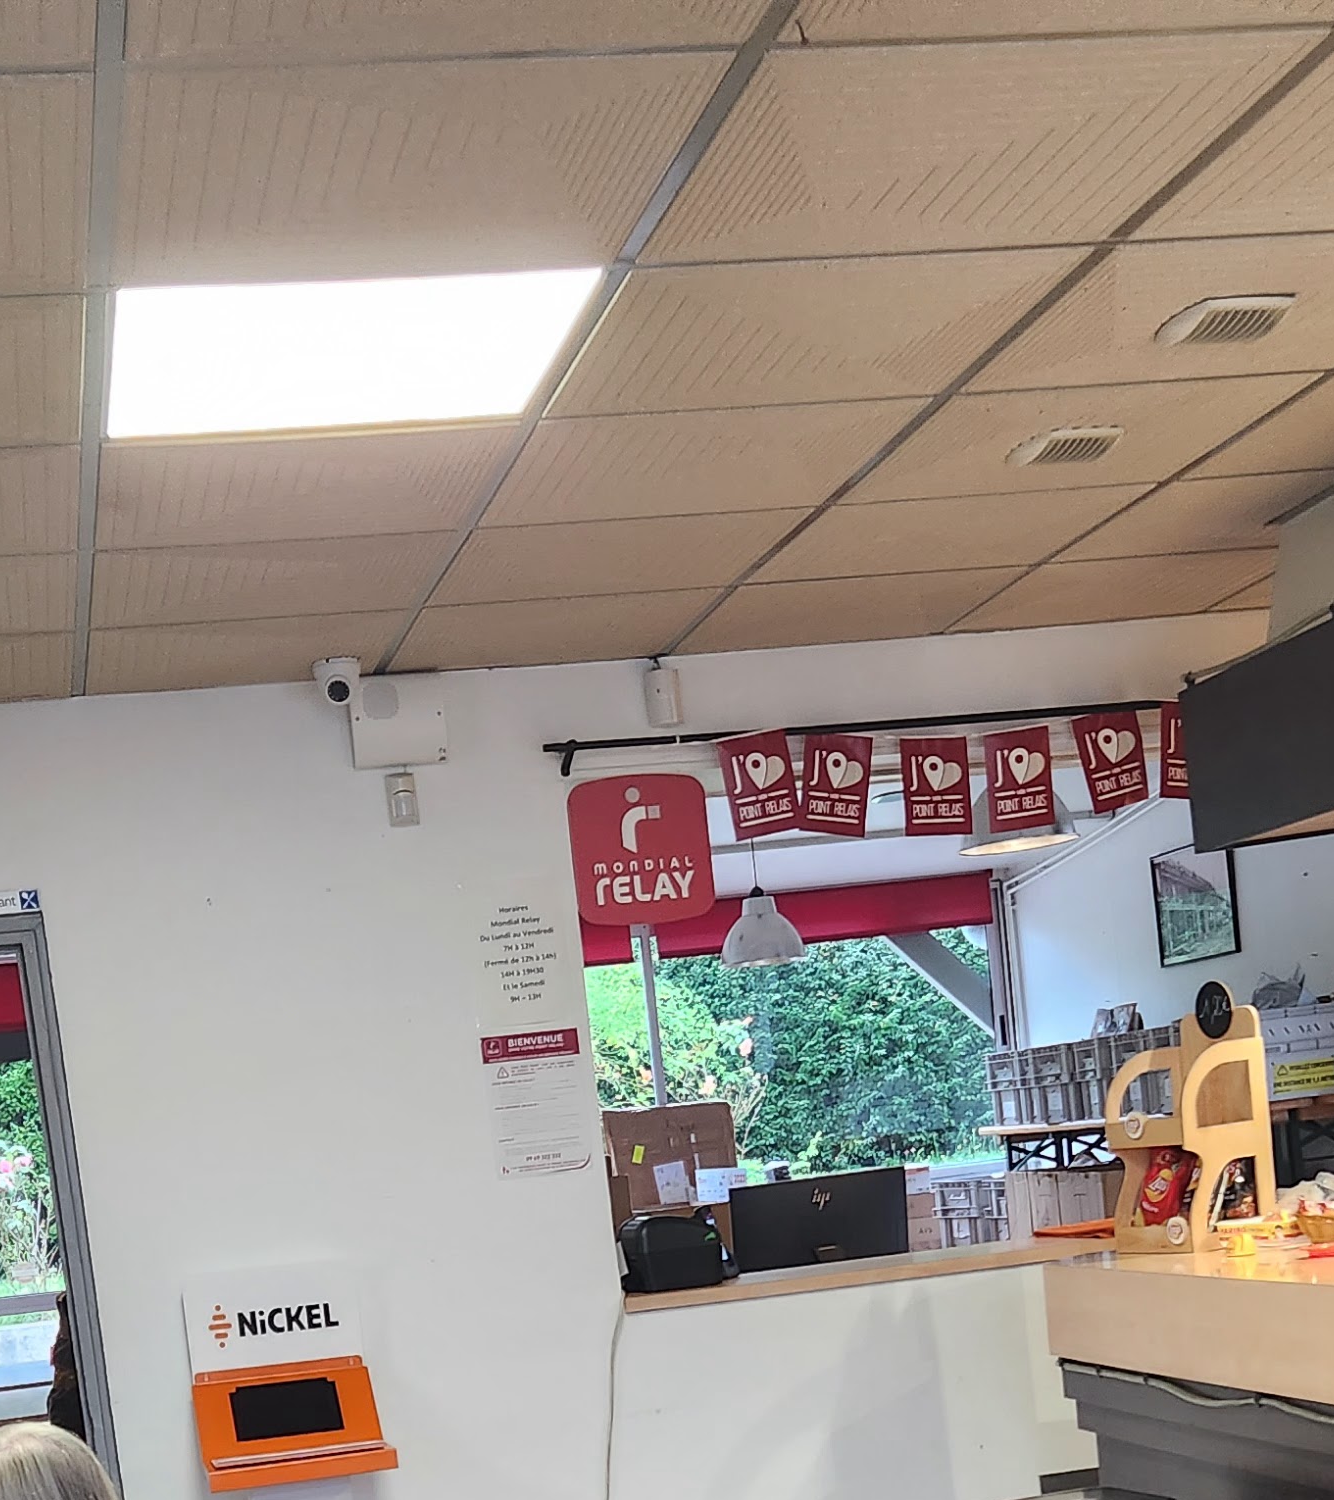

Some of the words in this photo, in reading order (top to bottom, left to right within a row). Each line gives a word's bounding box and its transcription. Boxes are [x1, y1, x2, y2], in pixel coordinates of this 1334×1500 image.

[1095, 779, 1118, 794] POINT
[1118, 768, 1143, 787] RELAIS
[738, 802, 764, 821] POINT
[764, 797, 793, 815] RELAIS
[808, 800, 833, 816] POINT
[833, 802, 861, 818] RELAIS
[912, 802, 937, 817] POINT
[937, 802, 965, 816] RELAIS
[996, 799, 1021, 814] POINT
[1021, 793, 1049, 810] RELAIS
[592, 855, 695, 876] MONDIAL
[594, 869, 696, 907] RELAY
[498, 905, 529, 914] Horaires
[490, 919, 520, 928] Mondial
[491, 932, 511, 941] Lundi
[522, 927, 554, 937] Vendredi
[519, 980, 545, 989] Samedi
[507, 1033, 564, 1048] BIENVENUE
